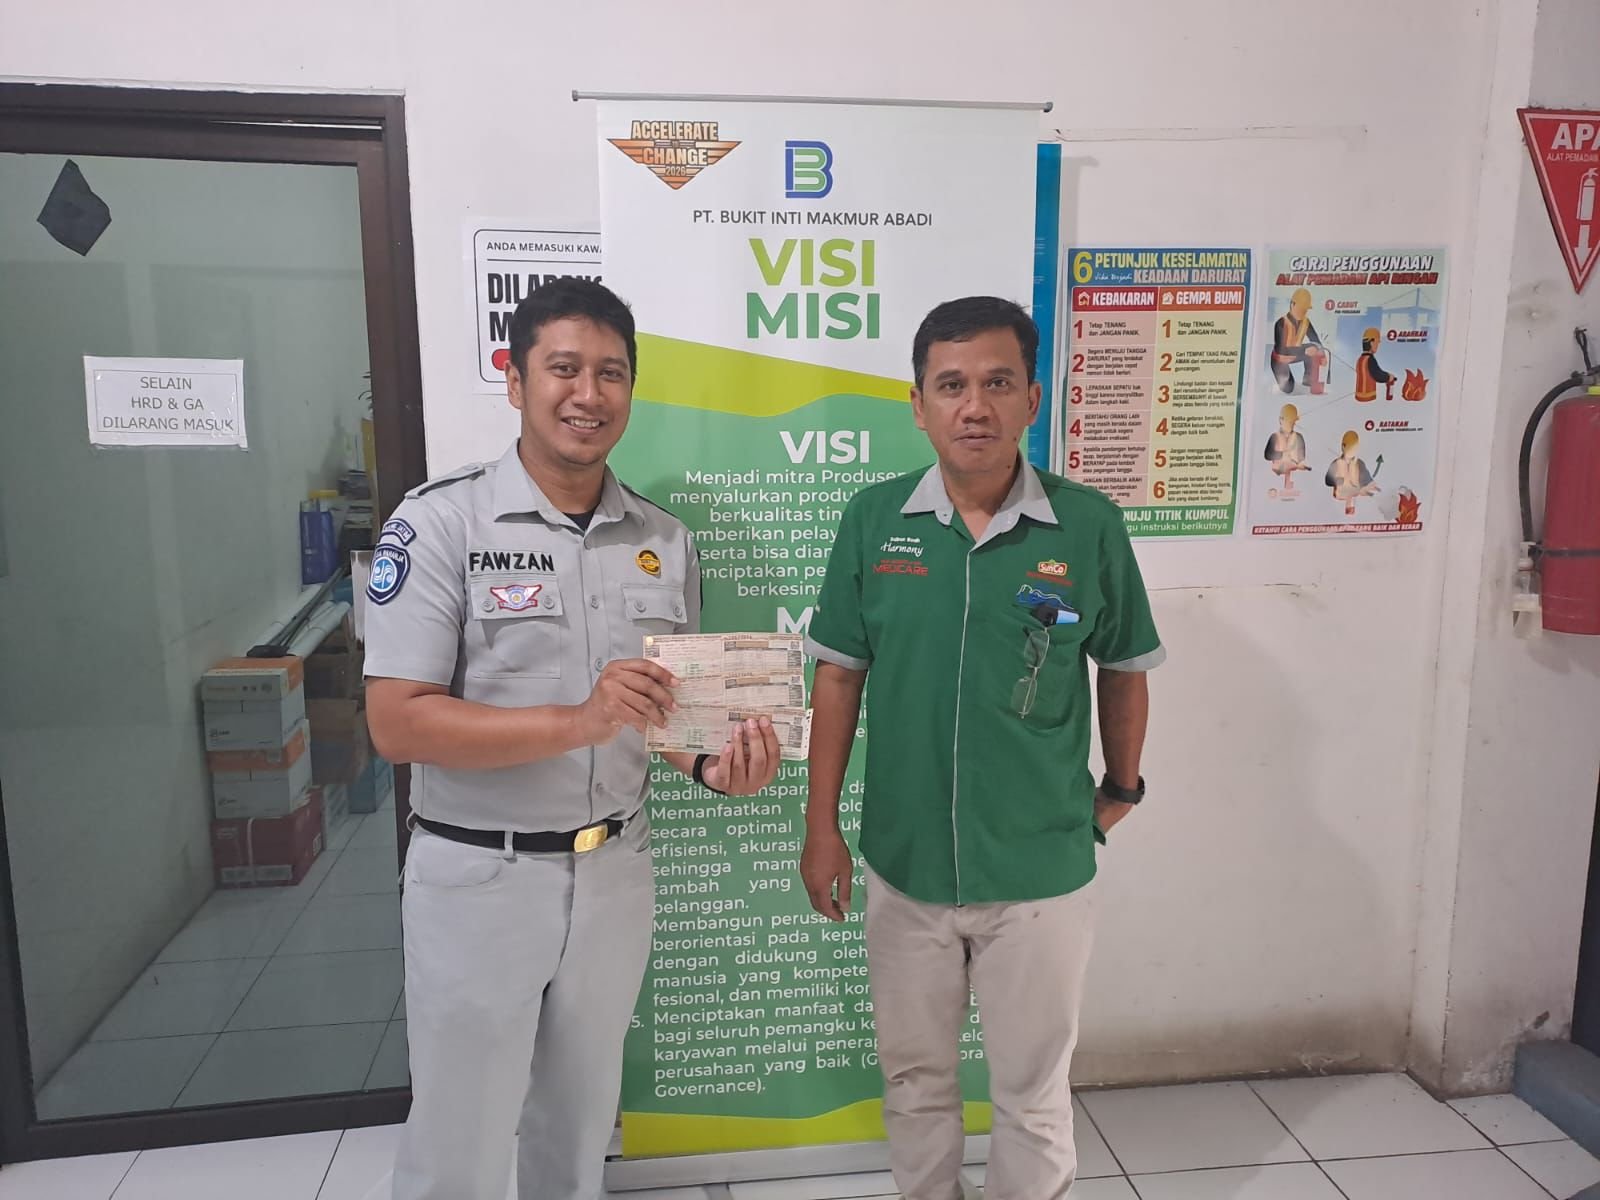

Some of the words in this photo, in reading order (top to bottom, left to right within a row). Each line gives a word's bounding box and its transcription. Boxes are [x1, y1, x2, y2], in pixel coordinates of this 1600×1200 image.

[632, 120, 718, 140] ACCELERATE
[643, 148, 708, 165] CHANGE
[1546, 152, 1564, 161] ALAT
[666, 166, 686, 177] 2026
[693, 210, 714, 224] PT.
[720, 211, 766, 225] BUKIT
[772, 212, 802, 225] INTI
[807, 213, 879, 226] MAKMUR
[884, 213, 933, 227] ABADI
[486, 241, 517, 252] ANDA
[519, 243, 574, 253] MEMASUKI
[749, 238, 876, 287] VISI
[1073, 251, 1093, 283] 6
[1095, 252, 1158, 268] PETUNJUK
[1162, 252, 1247, 268] KESELAMATAN
[1290, 256, 1328, 272] CARA
[1331, 255, 1434, 272] PENGGUNAAN
[1133, 269, 1188, 284] KEADAAN
[1192, 268, 1247, 283] DARURAT
[1276, 274, 1306, 286] ALAT
[1092, 291, 1155, 306] KEBAKARAN
[1176, 291, 1211, 305] GEMPA
[1214, 290, 1242, 305] BUMI
[746, 292, 881, 340] MISI
[1074, 319, 1083, 339] 1
[1162, 319, 1171, 338] 1
[1072, 353, 1085, 373] 2
[1160, 353, 1172, 372] 2
[140, 376, 192, 390] SELAIN
[132, 397, 162, 409] HRD
[168, 398, 179, 410] &
[184, 399, 205, 410] GA
[1071, 386, 1083, 405] 3
[1158, 385, 1170, 404] 3
[103, 417, 178, 430] DILARANG
[184, 418, 234, 431] MASUK
[1070, 419, 1082, 438] 4
[1156, 417, 1168, 436] 4
[780, 430, 870, 464] VISI
[1069, 451, 1080, 469] 5
[1154, 449, 1166, 468] 5
[686, 470, 760, 487] Menjadi
[766, 470, 815, 484] mitra
[670, 488, 793, 507] menyalurkan
[1153, 481, 1165, 499] 6
[710, 507, 813, 523] berkualitas
[1123, 511, 1151, 522] NUJU
[1155, 510, 1182, 521] TITIK
[1186, 509, 1229, 520] KUMPUL
[688, 526, 785, 543] emberikan
[1141, 521, 1179, 531] instruksi
[1182, 519, 1227, 532] berikutnya
[753, 546, 789, 560] bisa
[880, 542, 924, 558] Harmony
[469, 551, 555, 572] FAWZAN
[651, 801, 782, 821] Memanfaatkan
[651, 826, 707, 840] secara
[726, 820, 792, 838] optimal
[651, 842, 727, 859] efisiensi,
[653, 862, 731, 878] sehingga
[749, 875, 791, 894] yang
[654, 898, 750, 917] pelanggan.
[653, 915, 763, 933] Membangun
[653, 933, 756, 951] berorientasi
[768, 929, 810, 947] pada
[822, 928, 866, 944] kepu
[653, 955, 719, 971] dengan
[735, 950, 817, 965] didukung
[833, 945, 868, 960] oleh
[653, 971, 727, 988] manusia
[738, 970, 781, 986] yang
[653, 989, 724, 1007] fesional,
[729, 988, 761, 1002] dan
[766, 982, 840, 1000] memiliki
[631, 1015, 645, 1029] 5.
[653, 1006, 766, 1025] Menciptakan
[775, 1001, 844, 1018] manfaat
[654, 1027, 692, 1045] bagi
[696, 1023, 760, 1041] seluruh
[765, 1018, 856, 1039] pemangku
[654, 1046, 737, 1063] karyawan
[745, 1038, 807, 1056] melalui
[655, 1061, 755, 1082] perusahaan
[764, 1058, 806, 1076] yang
[816, 1053, 851, 1069] baik
[655, 1077, 767, 1098] Governance).
